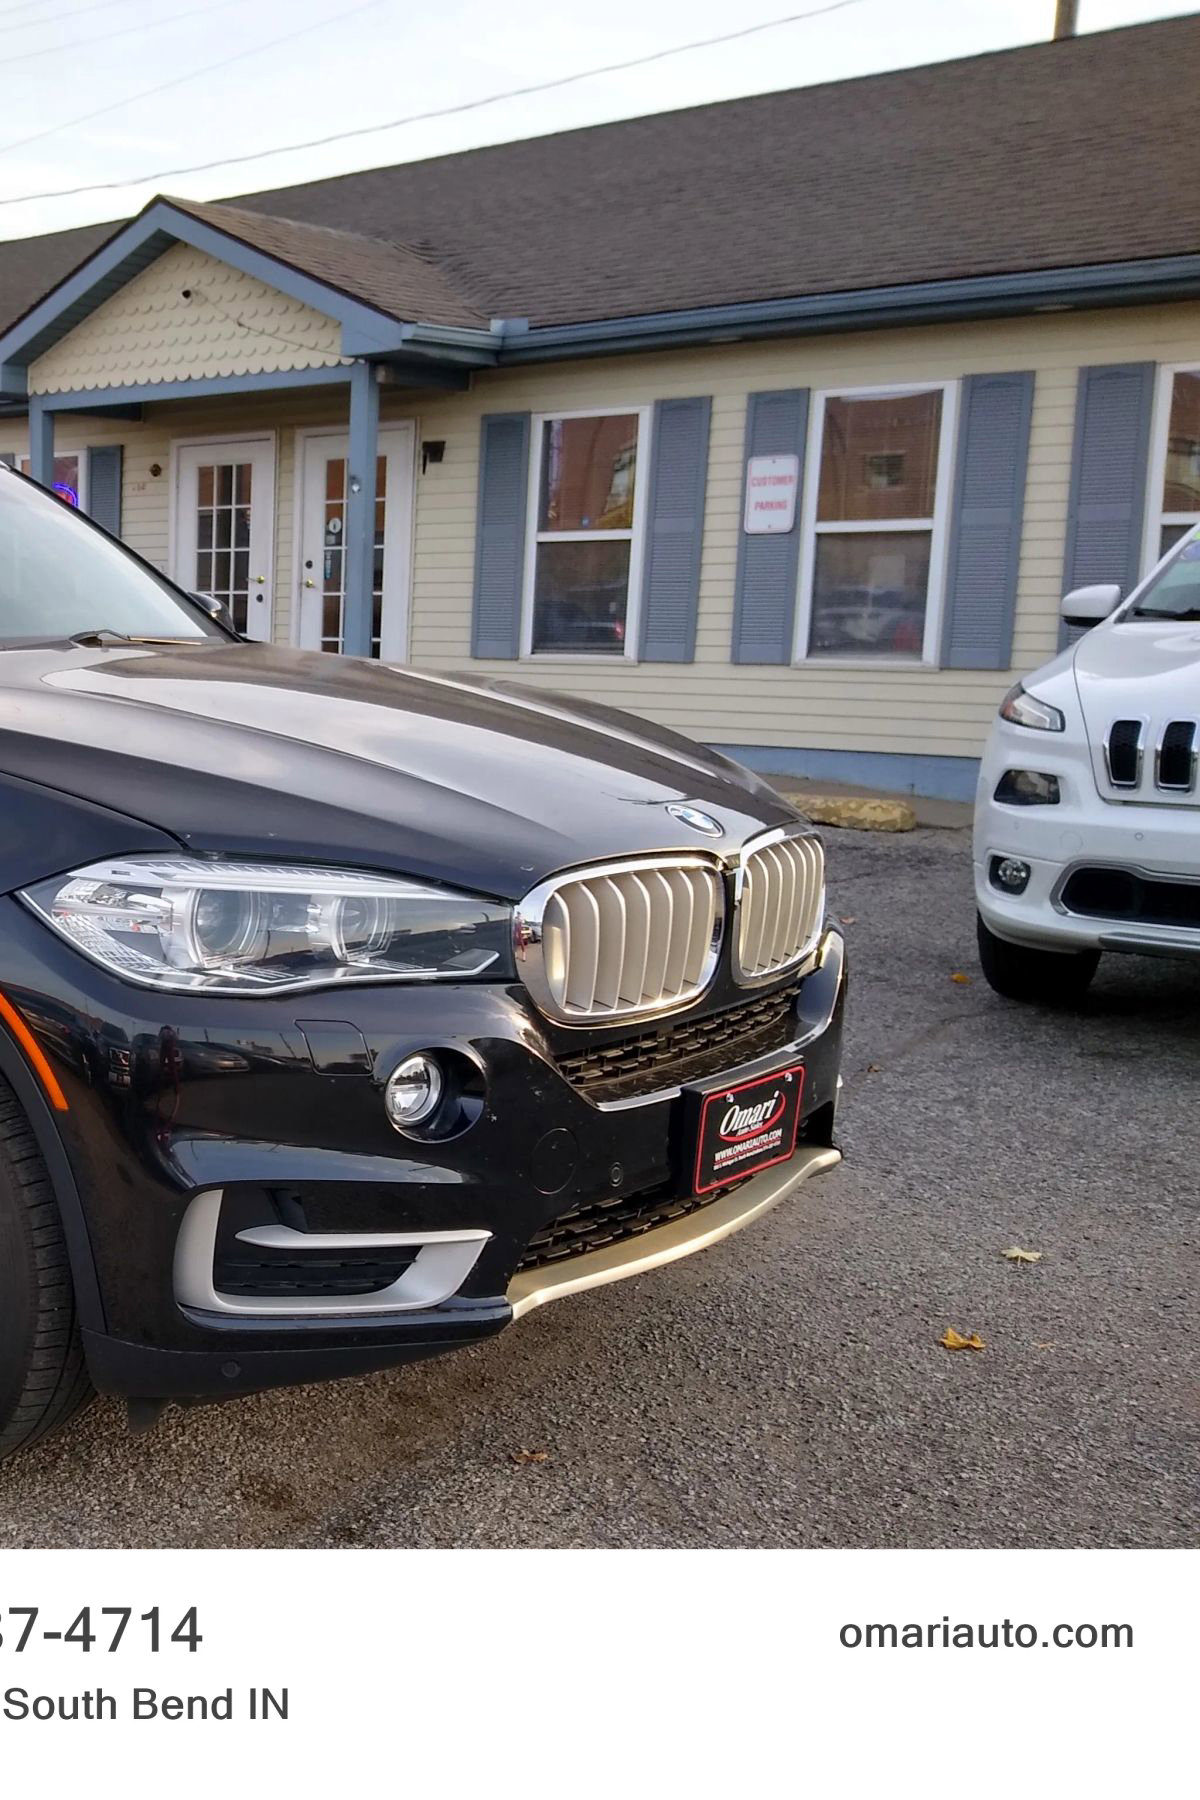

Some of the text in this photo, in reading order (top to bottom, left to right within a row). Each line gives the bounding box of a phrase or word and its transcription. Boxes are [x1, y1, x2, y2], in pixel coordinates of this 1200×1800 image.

[751, 474, 794, 488] CUSTOMER
[754, 500, 788, 512] PARKING
[719, 1089, 780, 1136] Omari
[714, 1127, 783, 1162] WWW.OMARIAUTO.COM
